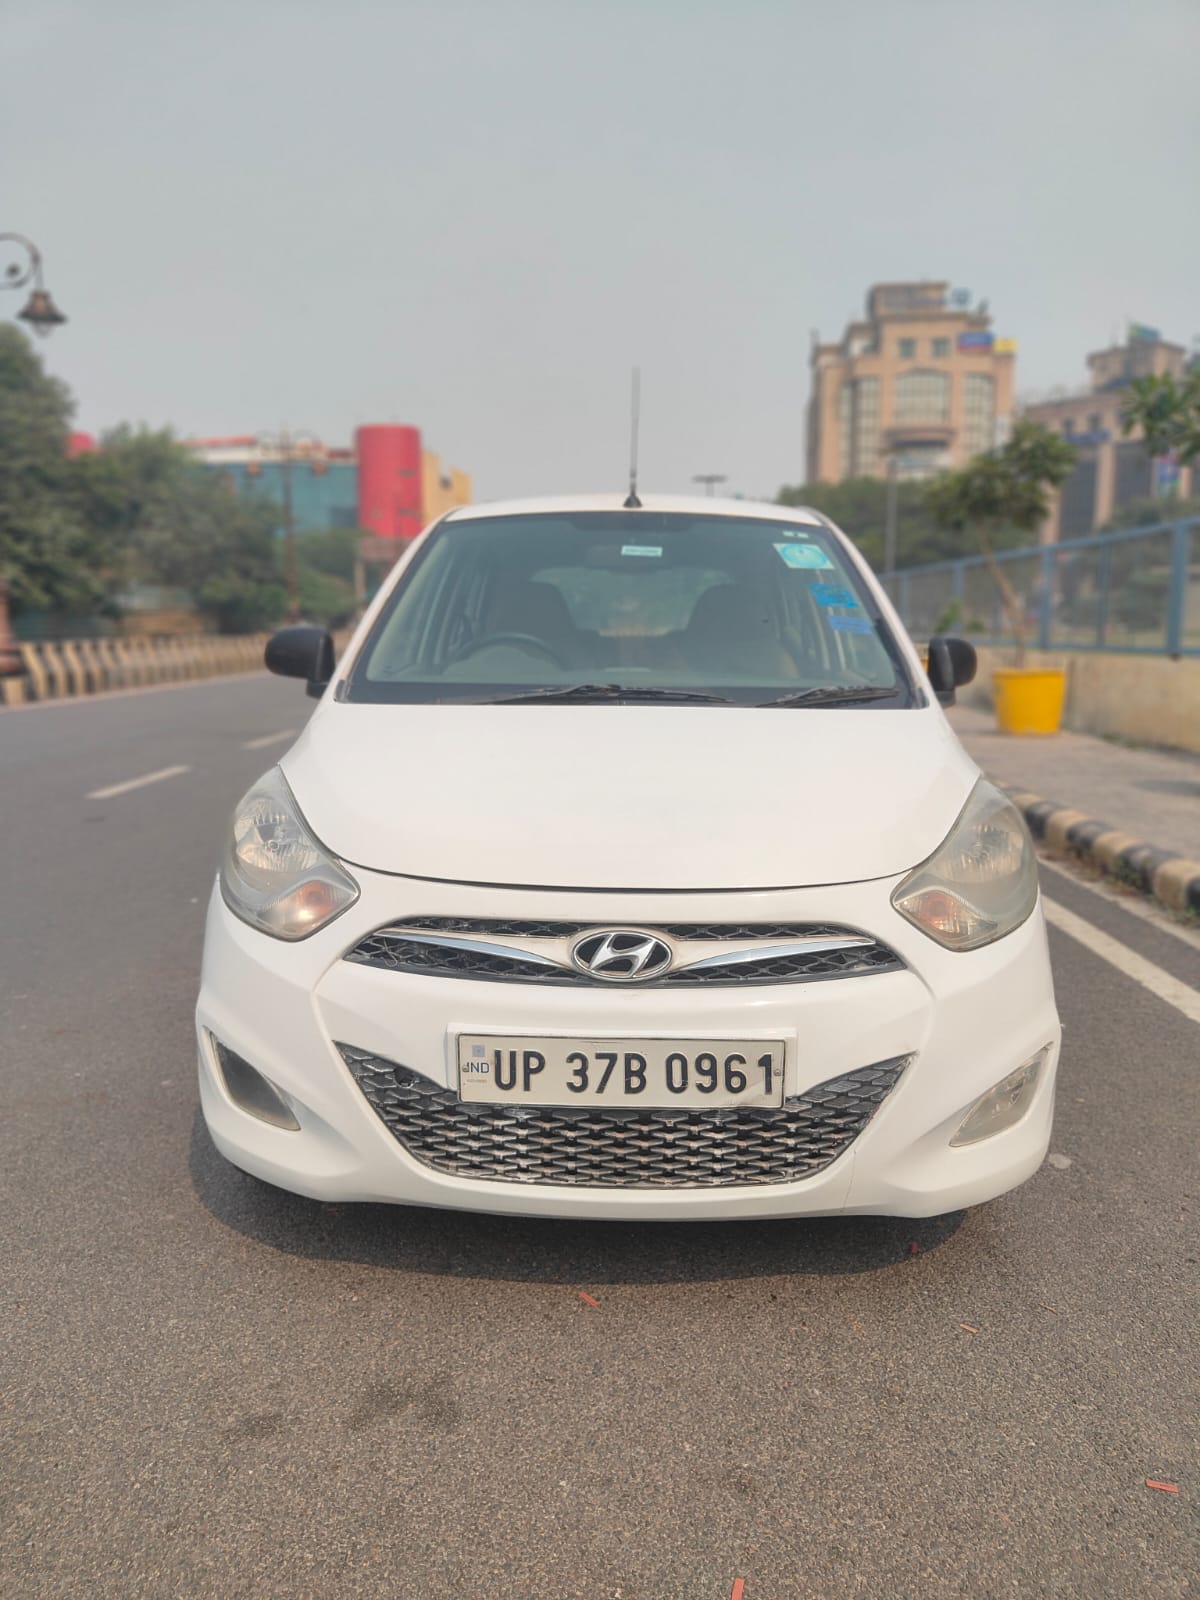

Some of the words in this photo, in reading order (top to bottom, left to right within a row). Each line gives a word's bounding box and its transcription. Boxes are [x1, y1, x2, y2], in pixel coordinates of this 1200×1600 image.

[494, 1049, 546, 1092] UP
[565, 1052, 647, 1094] 37B
[665, 1053, 772, 1095] 0961
